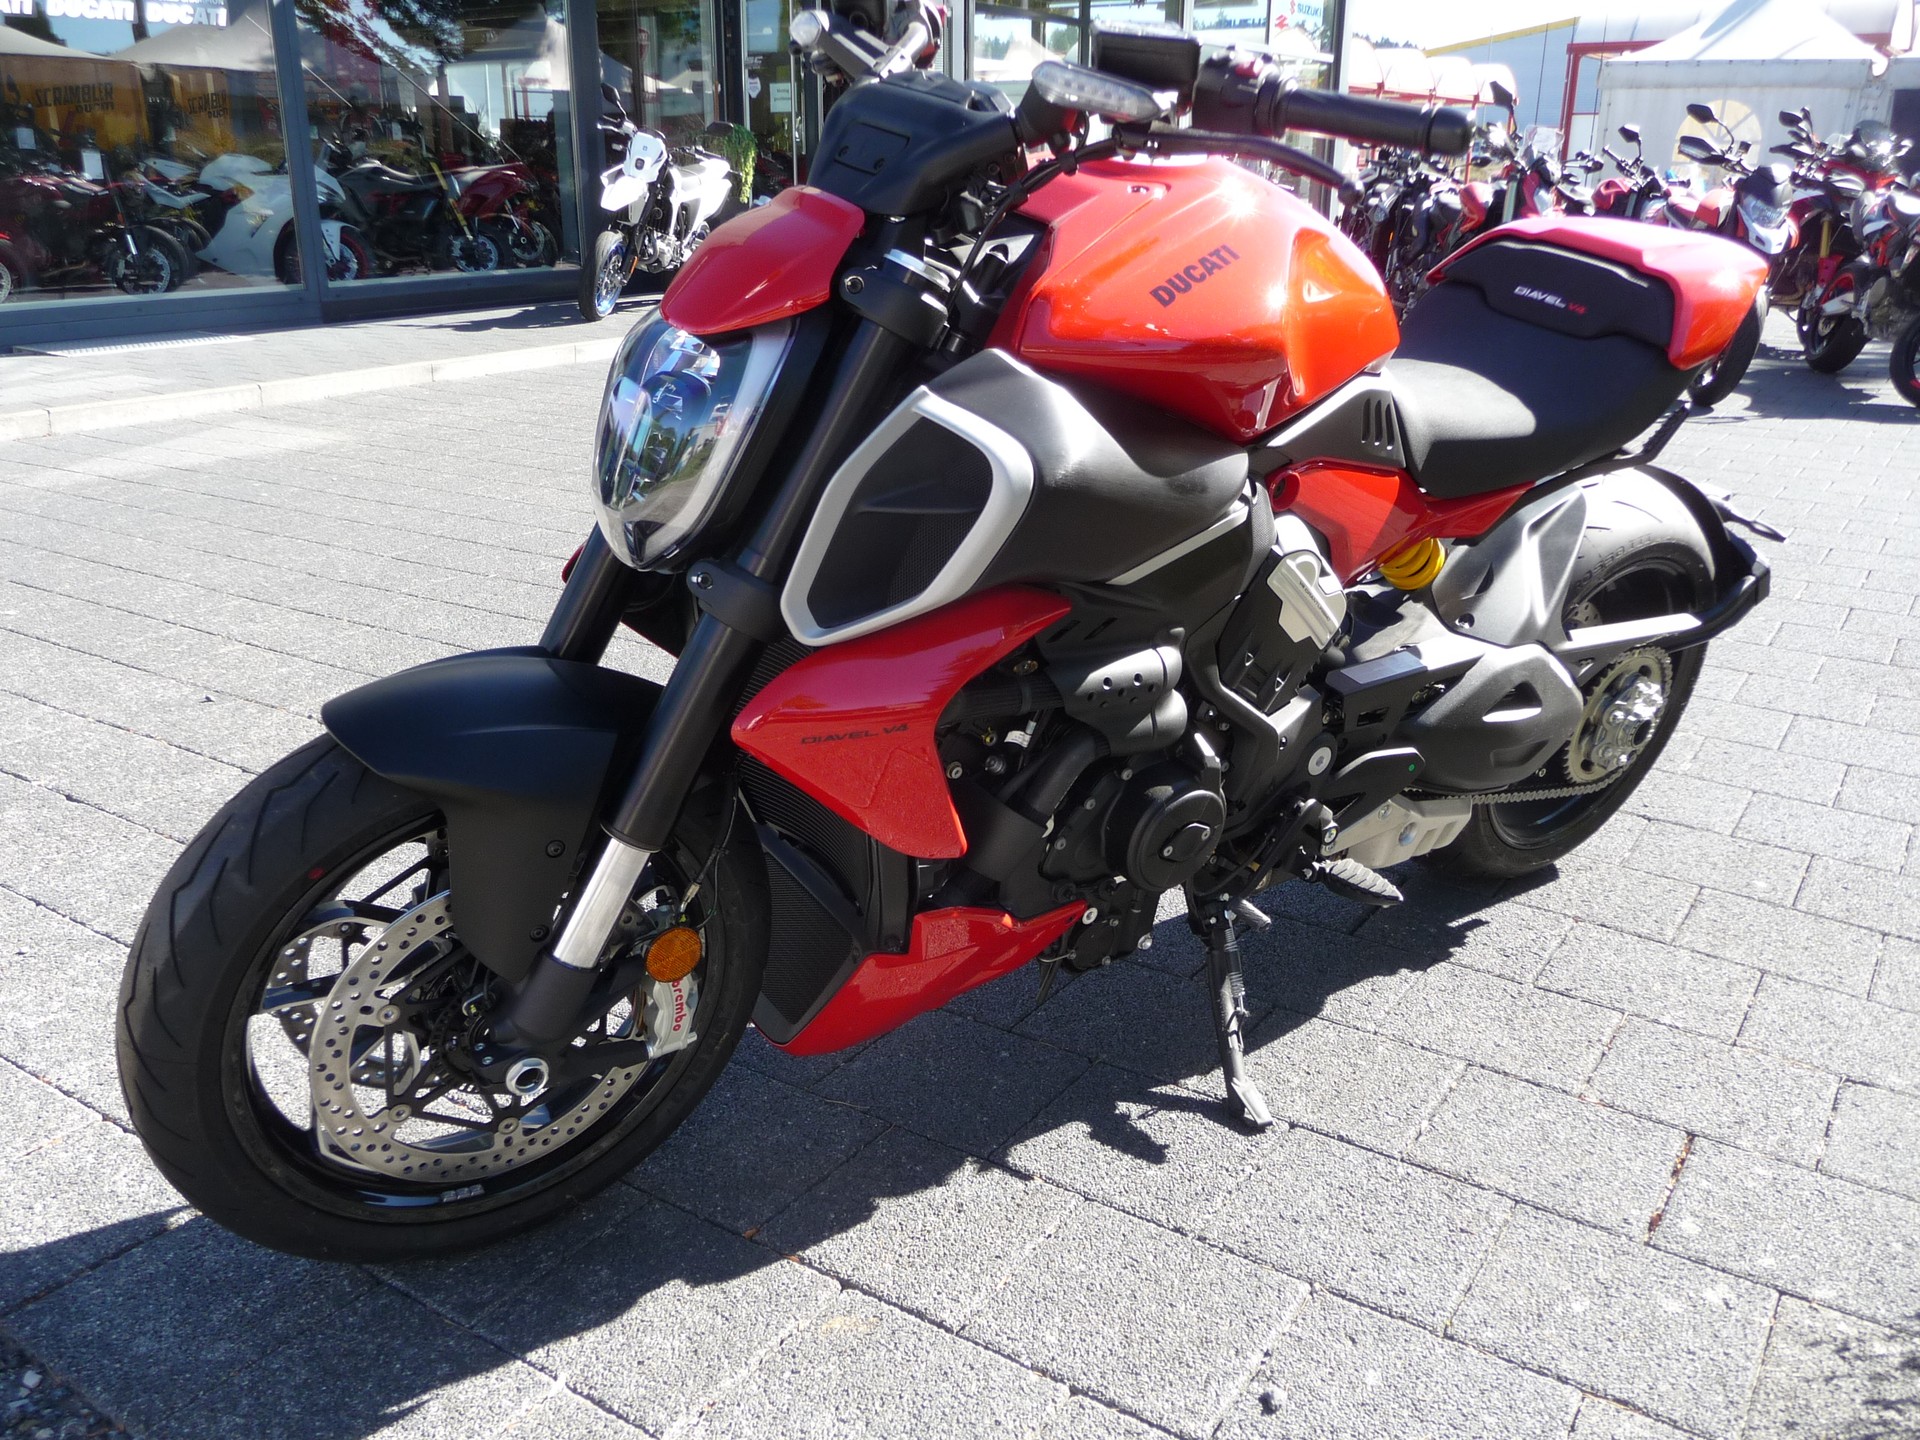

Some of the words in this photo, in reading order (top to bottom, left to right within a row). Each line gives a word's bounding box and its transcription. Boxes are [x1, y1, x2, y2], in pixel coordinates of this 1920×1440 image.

[146, 1, 227, 26] DUCATI
[1297, 3, 1322, 17] SUZUKI
[35, 82, 114, 108] SCRAMBLER
[1149, 244, 1241, 308] DUCATI
[1514, 285, 1567, 308] DIAVEL
[801, 730, 880, 744] DIAVEL
[883, 723, 909, 735] V4
[671, 979, 687, 1031] brembo
